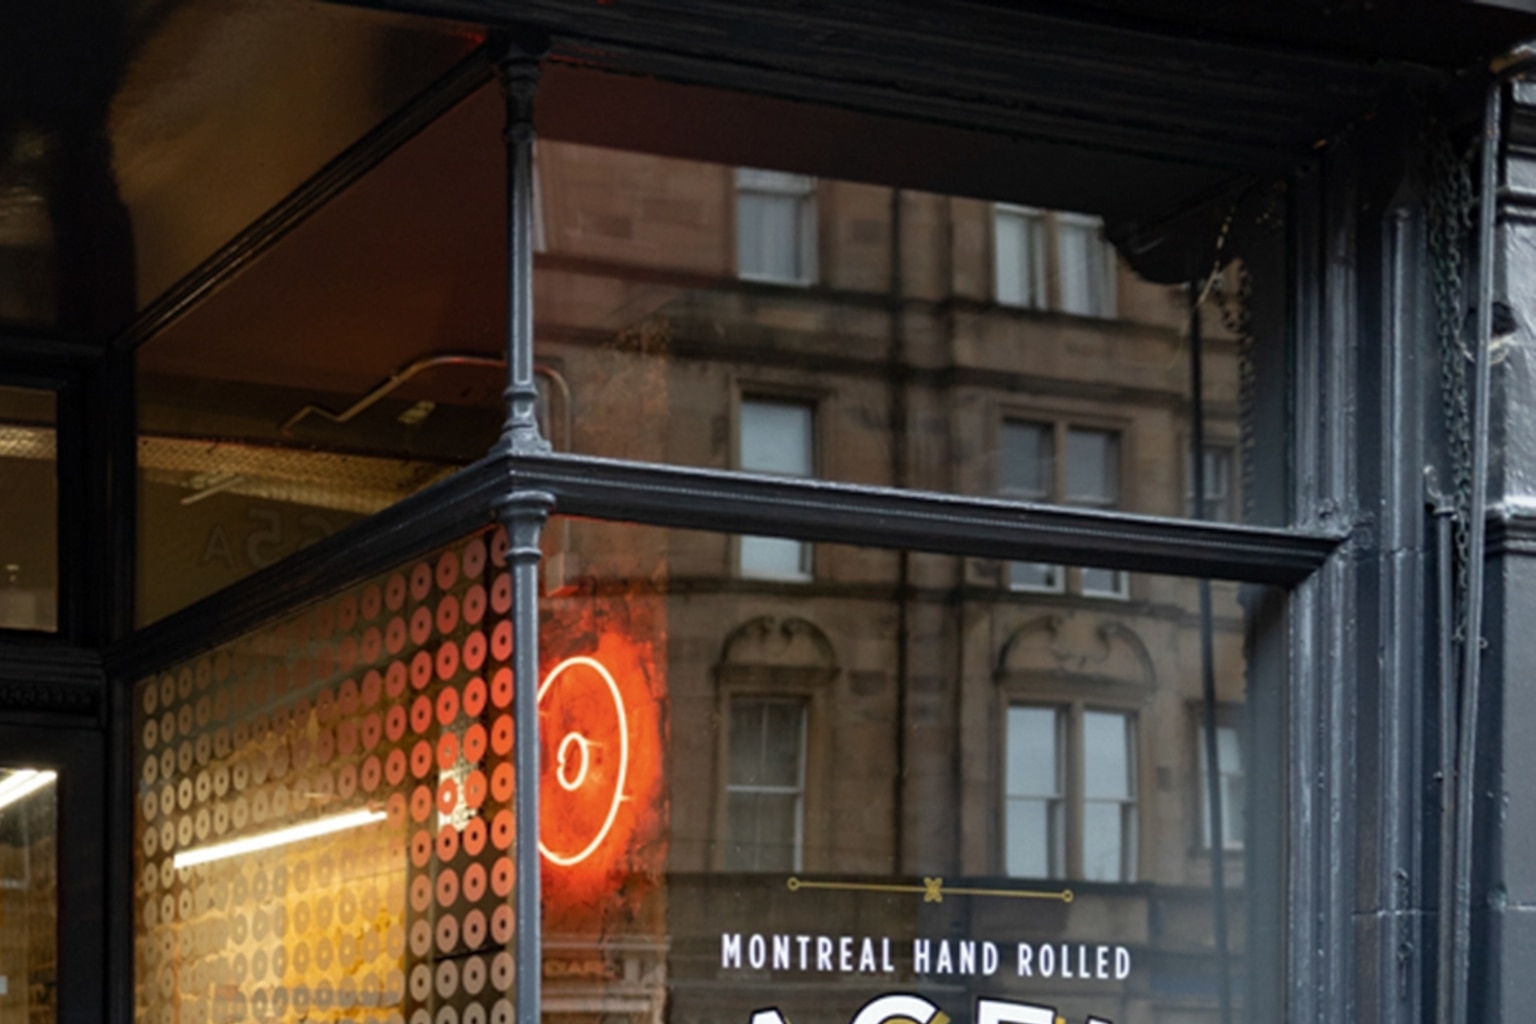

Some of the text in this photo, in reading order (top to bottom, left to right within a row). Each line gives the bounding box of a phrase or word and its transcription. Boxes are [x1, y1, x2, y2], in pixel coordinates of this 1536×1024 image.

[722, 933, 1131, 980] MONTREAL HAND ROLLED
